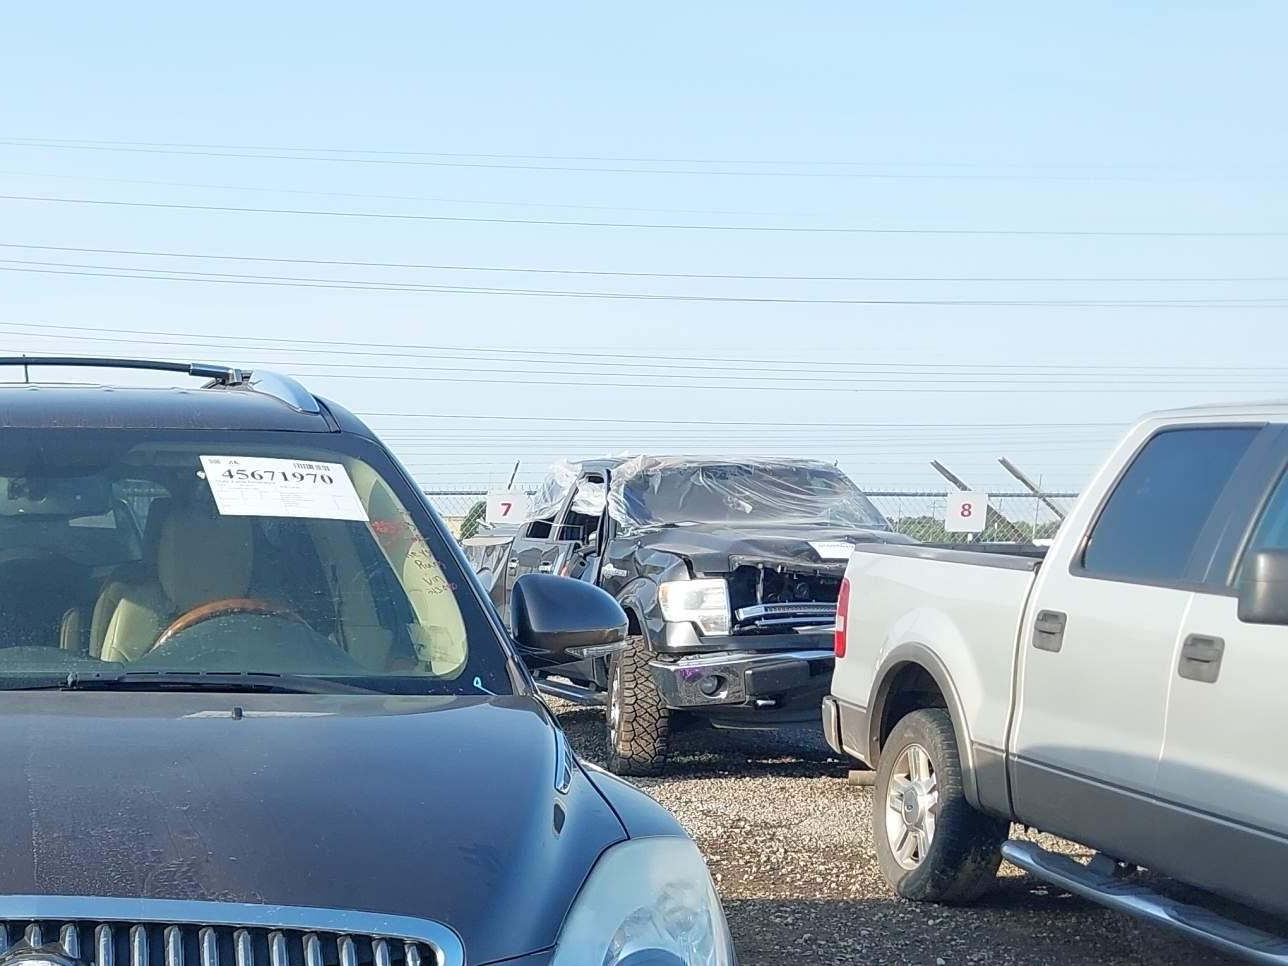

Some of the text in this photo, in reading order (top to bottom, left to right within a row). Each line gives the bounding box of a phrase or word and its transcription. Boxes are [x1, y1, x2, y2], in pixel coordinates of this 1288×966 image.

[222, 469, 333, 485] 45671970
[501, 503, 512, 516] 7
[960, 503, 972, 517] 8
